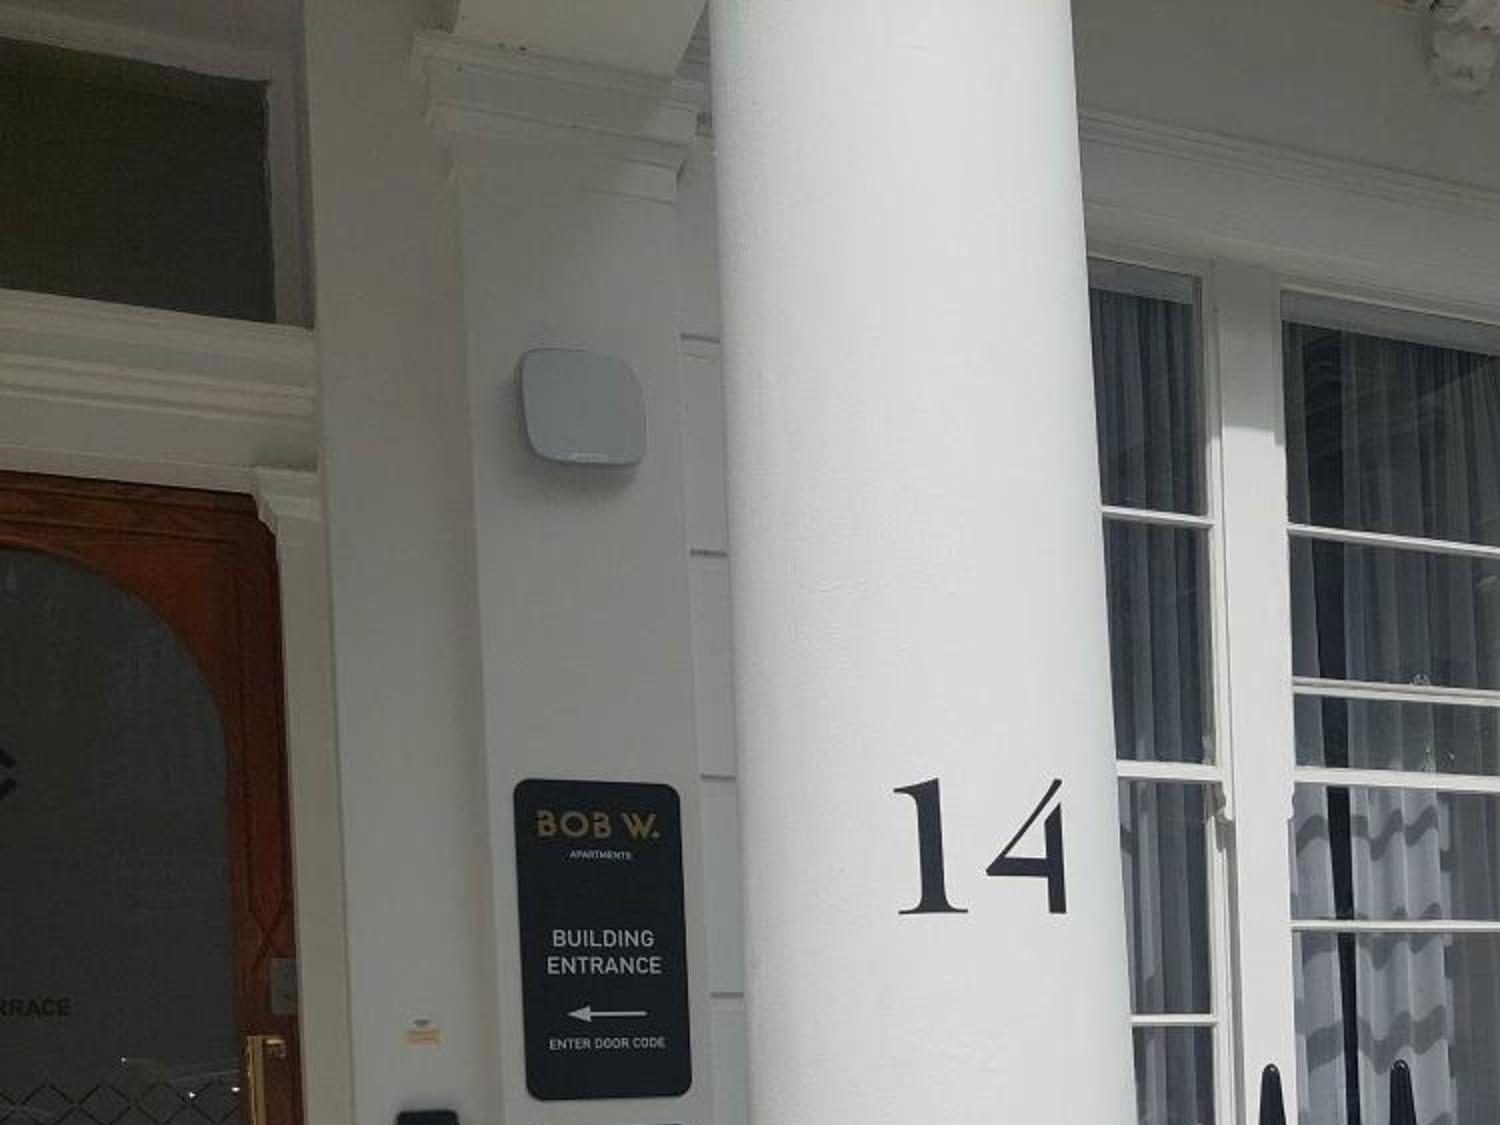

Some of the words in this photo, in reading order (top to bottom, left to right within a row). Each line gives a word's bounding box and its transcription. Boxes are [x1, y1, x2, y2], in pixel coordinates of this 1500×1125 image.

[536, 810, 612, 839] BOB
[621, 812, 660, 839] W.
[569, 849, 632, 860] APARTMENTS
[893, 777, 1067, 914] 14
[553, 929, 655, 948] BUILDING
[547, 956, 662, 975] ENTRANCE
[549, 1038, 591, 1050] ENTER
[595, 1037, 629, 1049] DOOR
[632, 1036, 666, 1049] CODE
